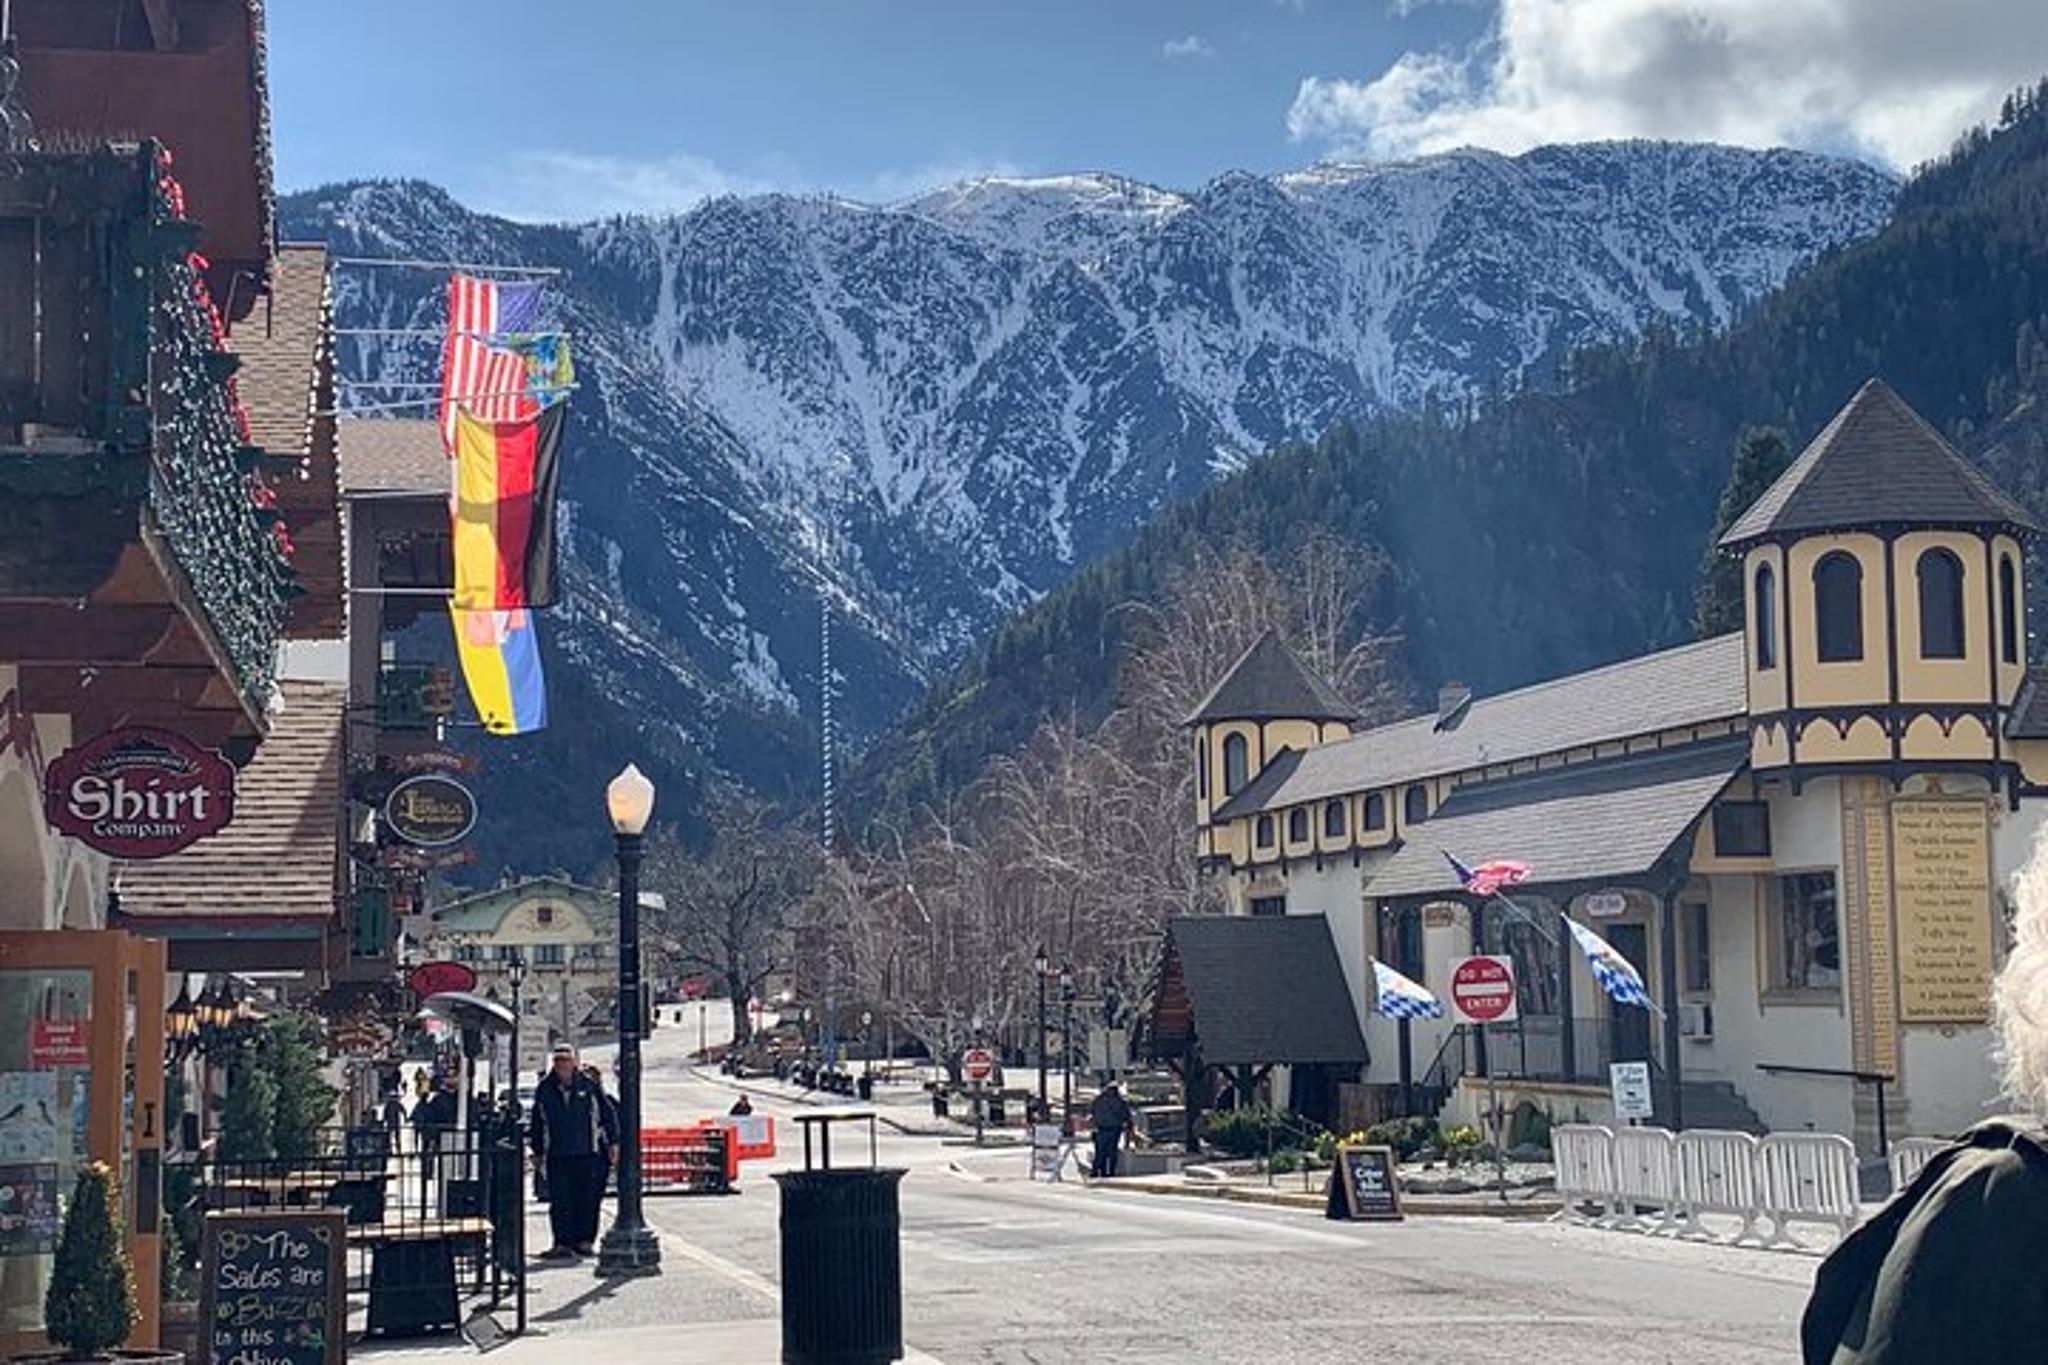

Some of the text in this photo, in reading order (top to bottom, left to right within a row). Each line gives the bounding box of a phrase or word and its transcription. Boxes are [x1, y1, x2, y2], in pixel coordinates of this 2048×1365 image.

[67, 775, 211, 820] Shirt
[92, 820, 186, 839] Company
[252, 1230, 310, 1260] The
[218, 1262, 323, 1290] Sales are
